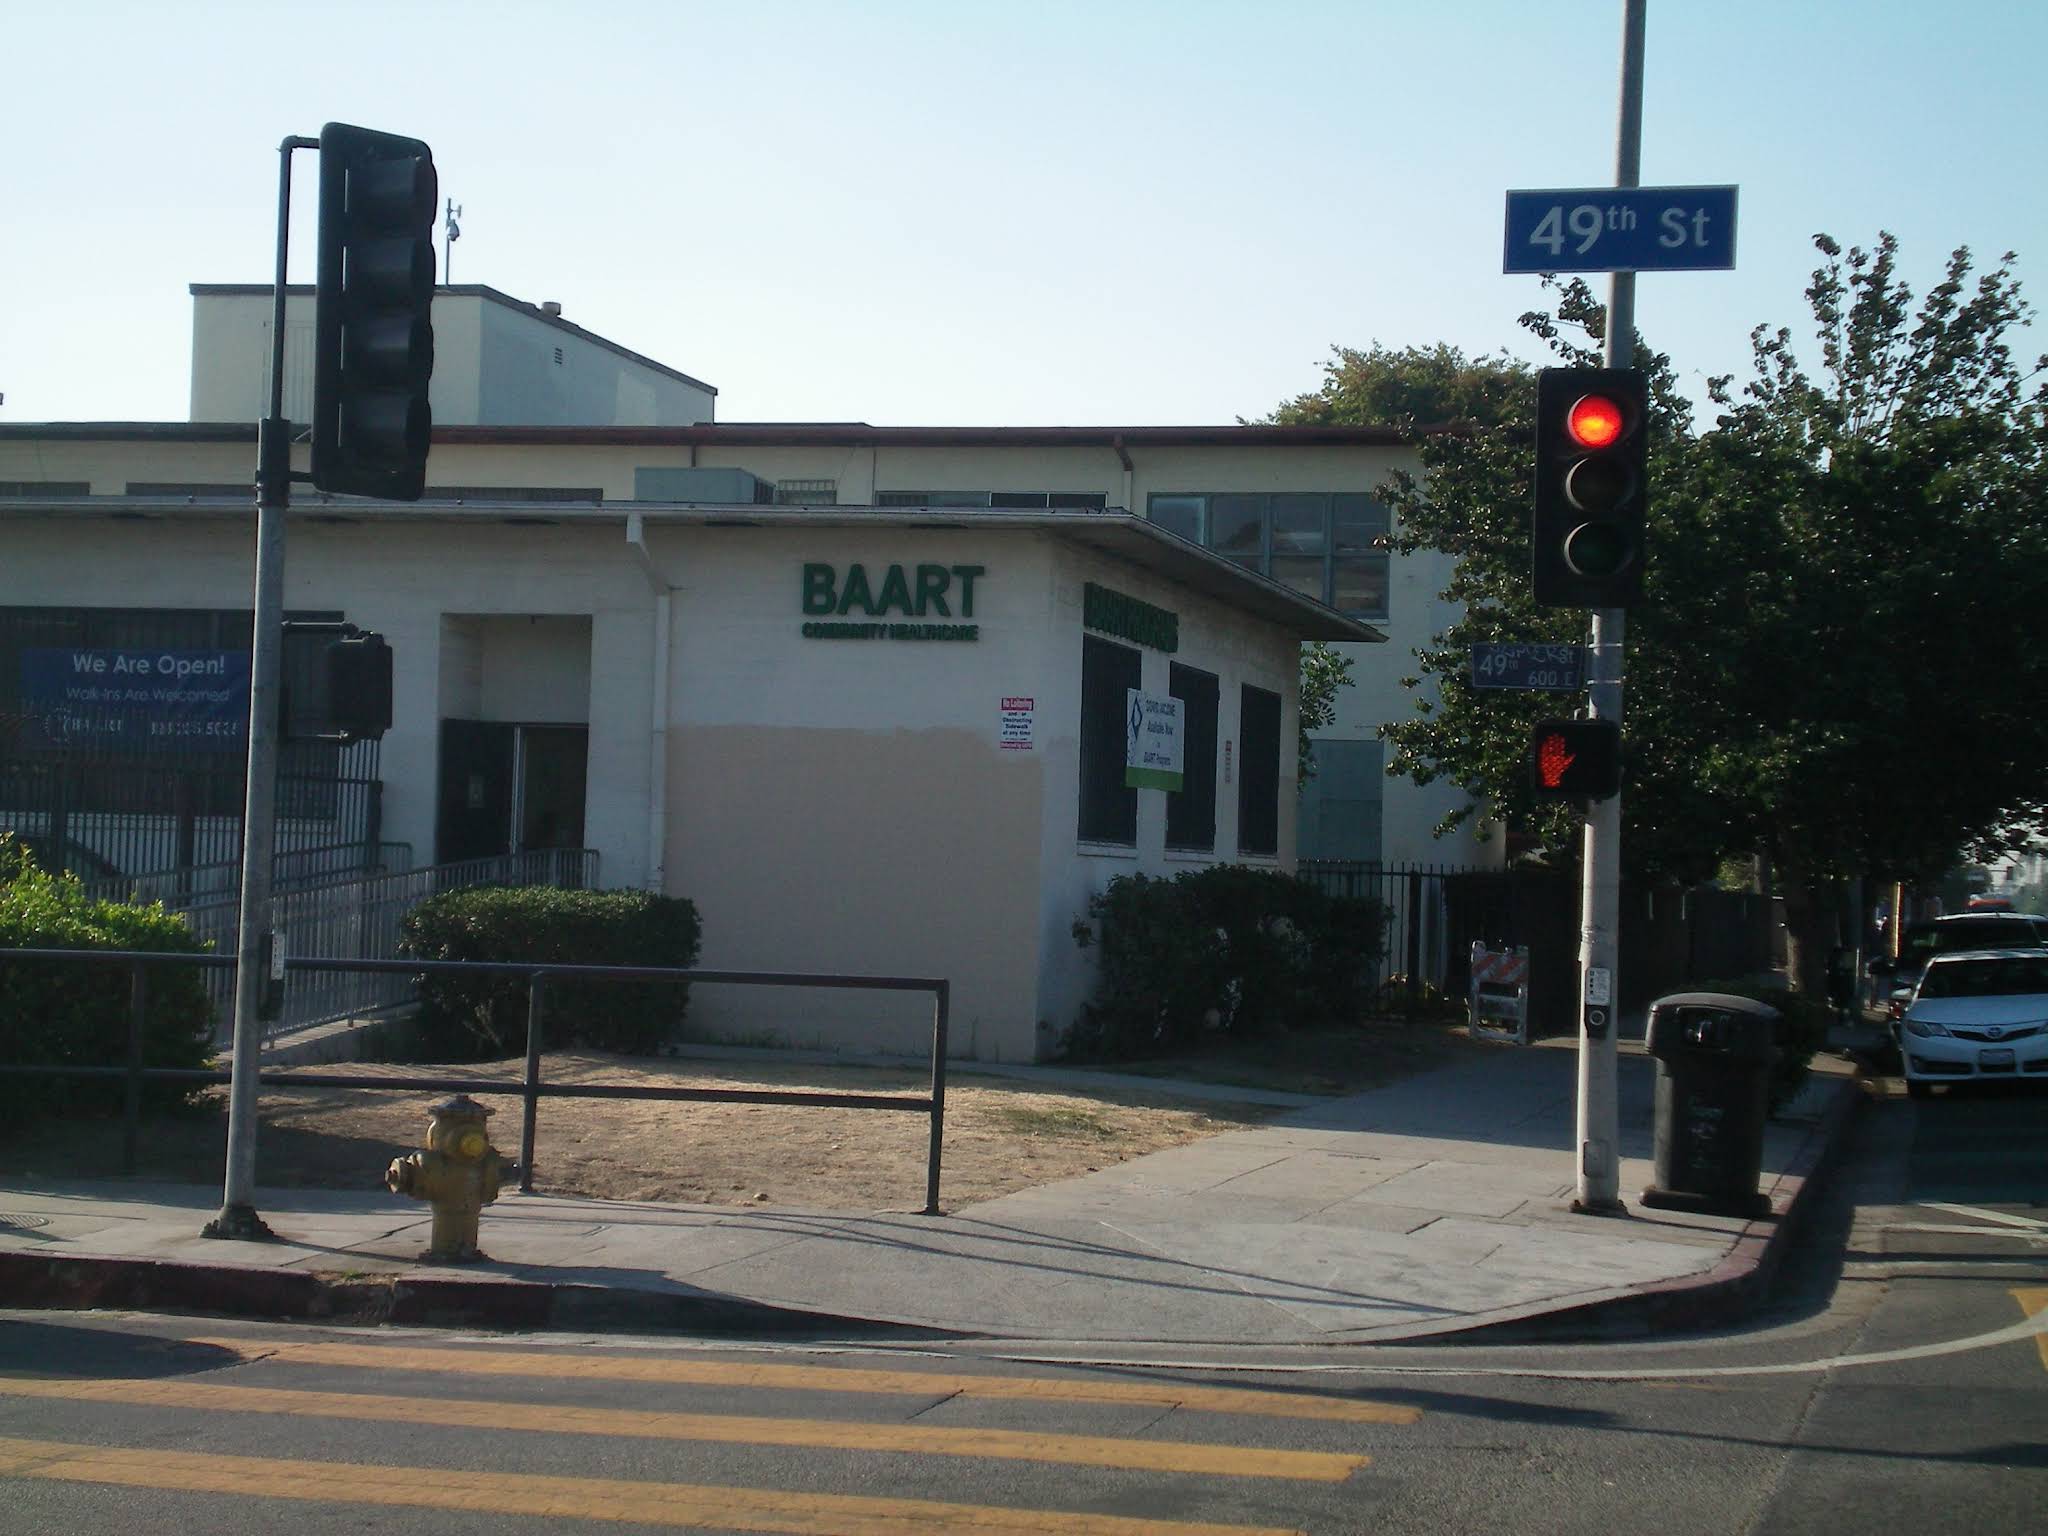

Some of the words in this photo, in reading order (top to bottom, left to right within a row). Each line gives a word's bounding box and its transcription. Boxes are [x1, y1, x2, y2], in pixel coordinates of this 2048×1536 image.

[1529, 204, 1637, 256] 49th
[1658, 207, 1712, 248] St
[801, 562, 985, 618] BAART
[73, 654, 107, 674] We
[113, 655, 150, 675] Are
[157, 655, 226, 679] Open!
[1479, 653, 1519, 677] 49th
[1528, 670, 1557, 686] 600
